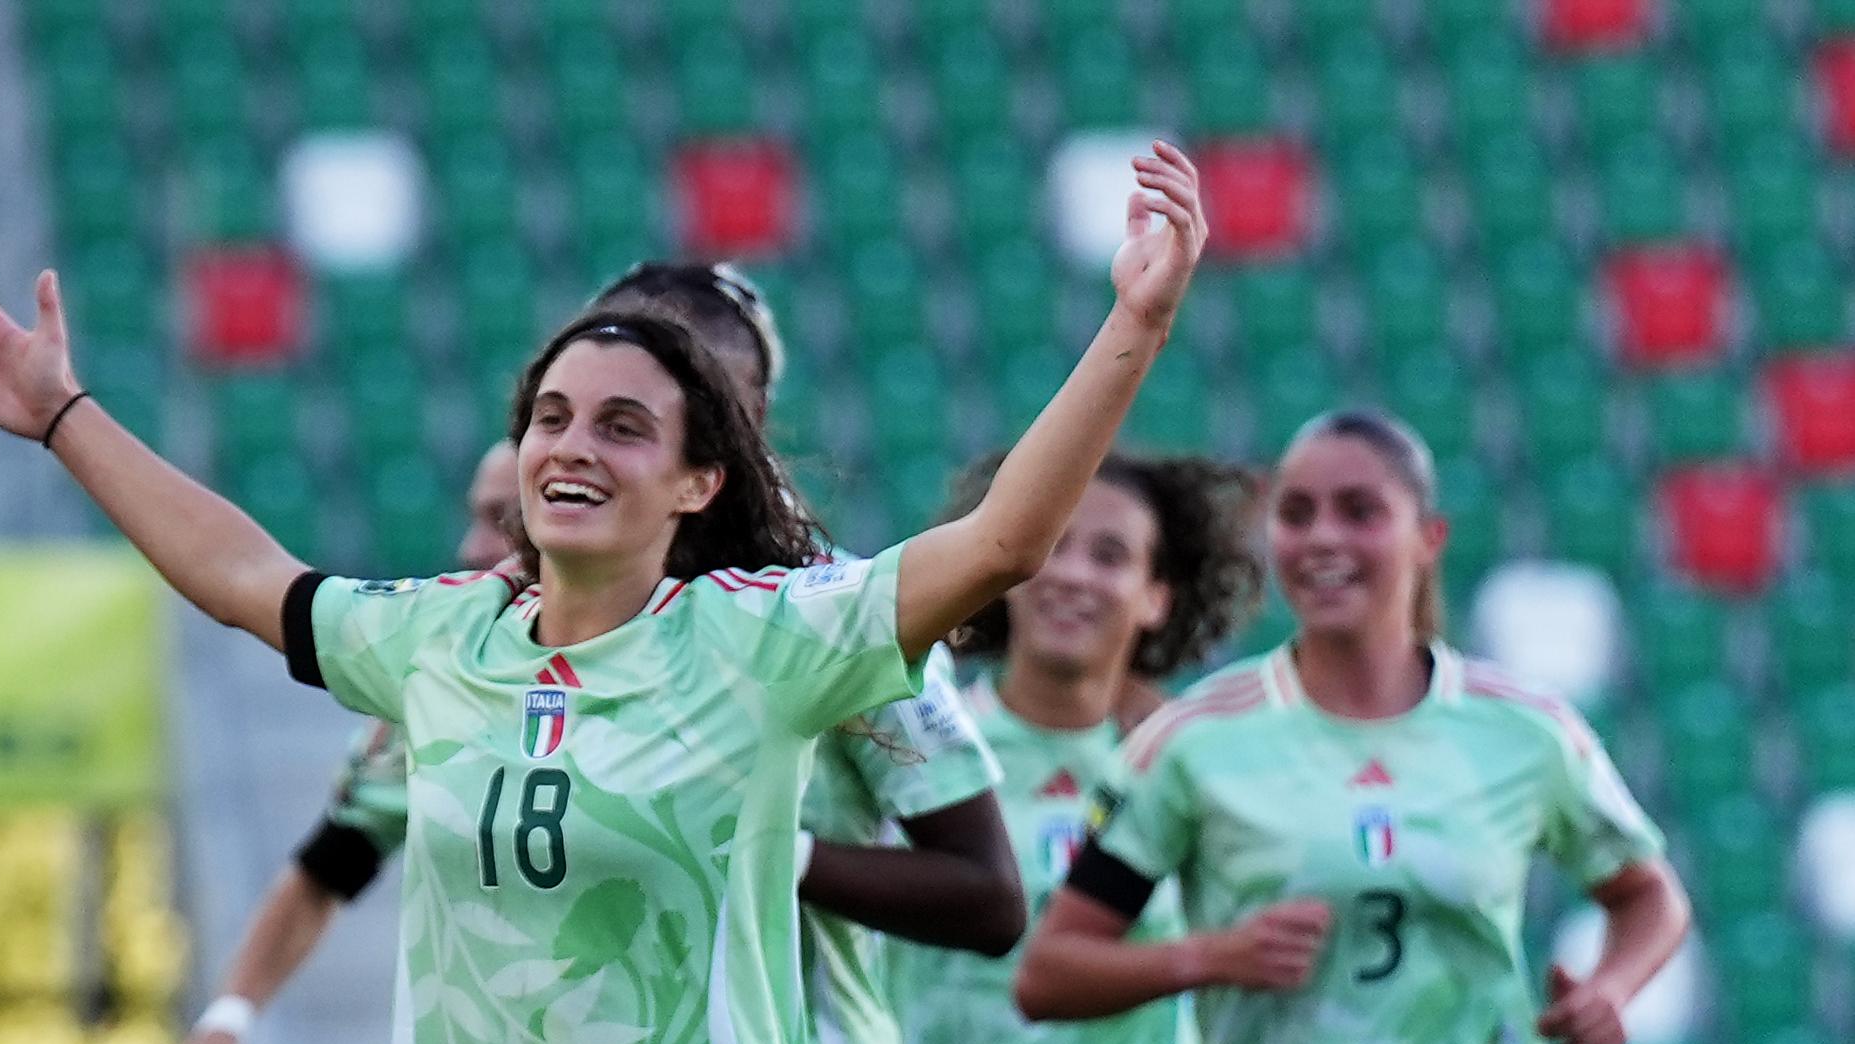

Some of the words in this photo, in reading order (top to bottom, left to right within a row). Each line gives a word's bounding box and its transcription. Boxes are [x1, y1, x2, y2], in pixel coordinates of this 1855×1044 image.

[526, 692, 565, 709] ITALIA
[478, 765, 571, 890] 18
[1352, 890, 1406, 982] 3
